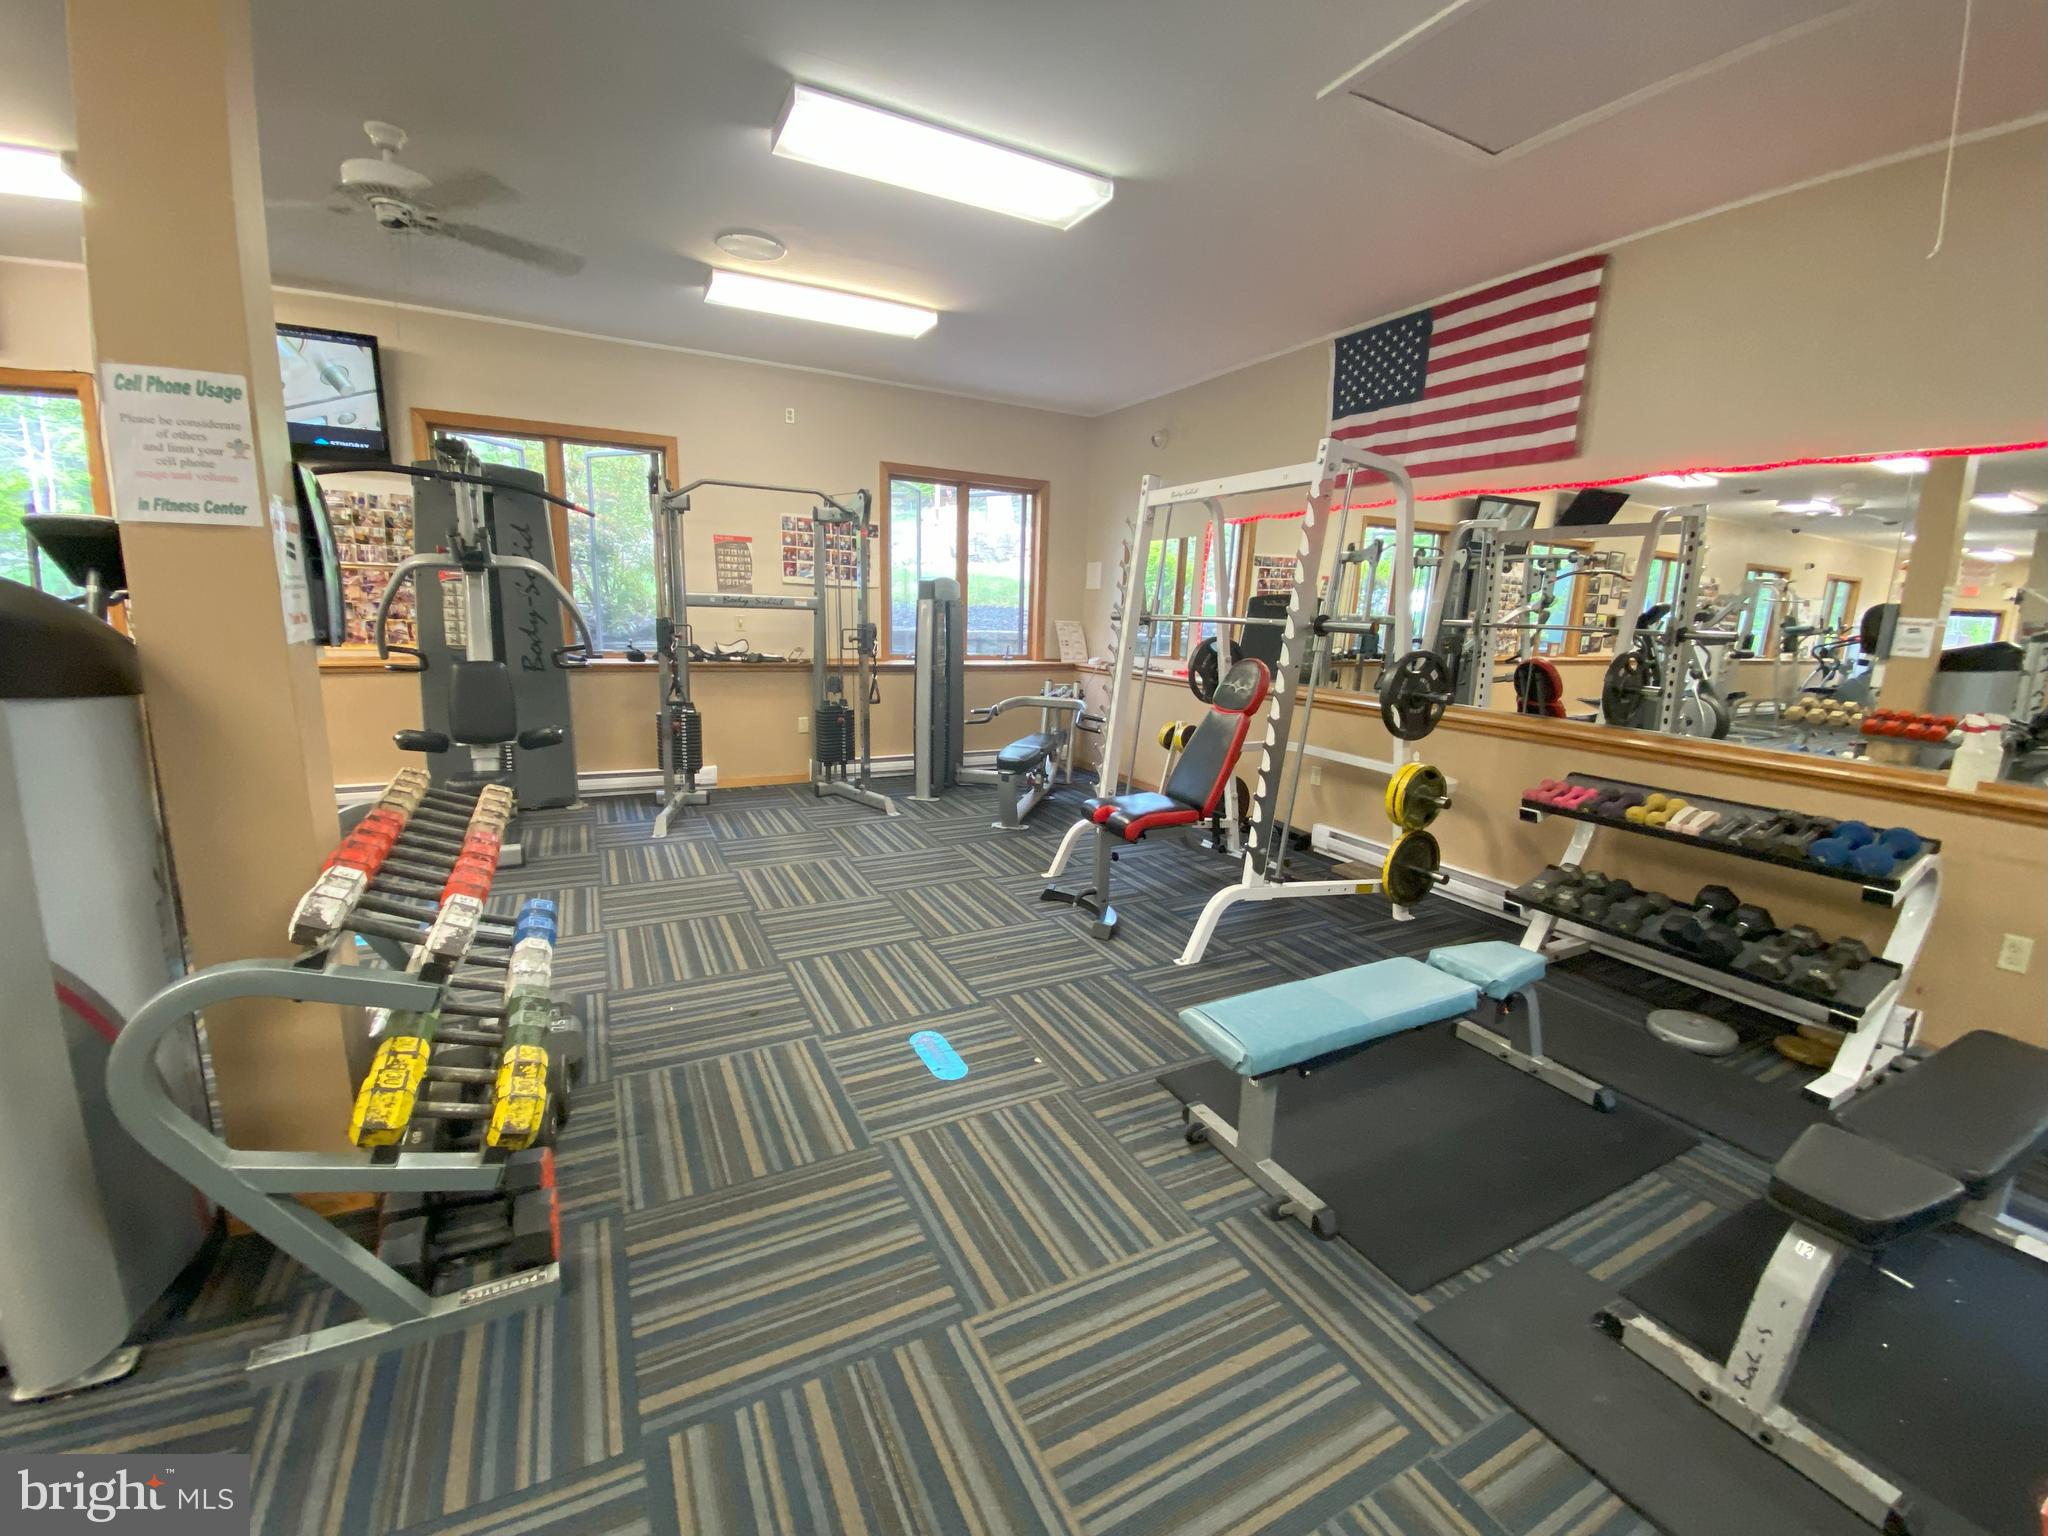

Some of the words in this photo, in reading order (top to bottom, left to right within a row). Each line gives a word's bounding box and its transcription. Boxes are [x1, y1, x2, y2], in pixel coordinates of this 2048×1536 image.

[114, 373, 142, 392] Cell
[146, 375, 191, 395] Phone
[196, 379, 242, 403] Usage
[119, 413, 155, 424] Please
[159, 415, 173, 426] be
[176, 418, 241, 431] considerate
[156, 429, 169, 438] of
[143, 443, 164, 452] and
[168, 443, 194, 454] limit
[198, 447, 223, 457] your
[155, 456, 176, 466] cell
[180, 457, 215, 469] phone
[138, 497, 149, 511] in
[154, 498, 199, 513] Fitness
[204, 500, 248, 515] Center
